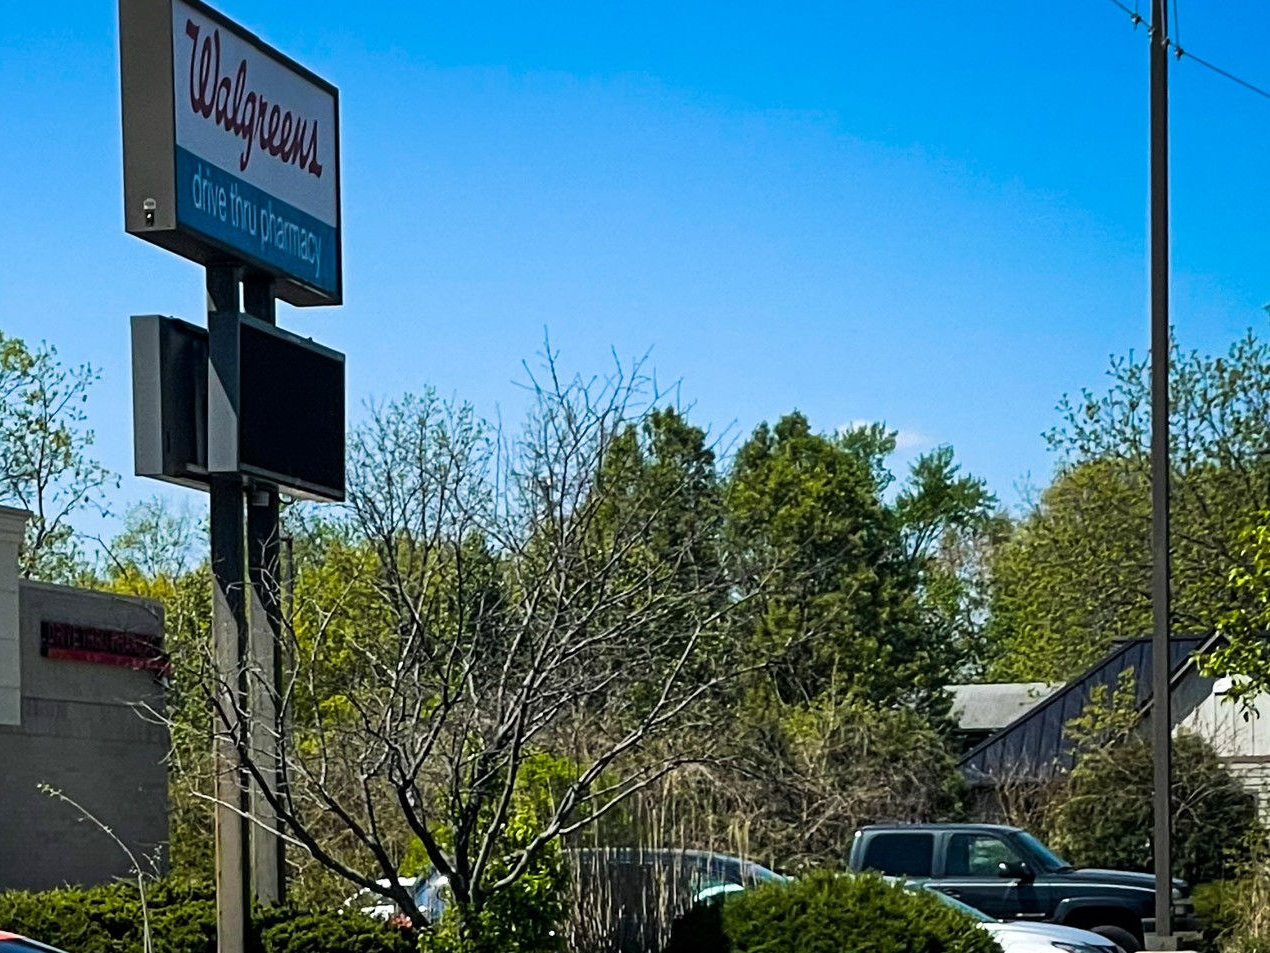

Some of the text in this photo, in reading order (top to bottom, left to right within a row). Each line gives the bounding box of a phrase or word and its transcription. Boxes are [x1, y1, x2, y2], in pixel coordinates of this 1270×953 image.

[185, 18, 322, 178] Walgreens
[192, 164, 321, 278] drive thru pharmacy
